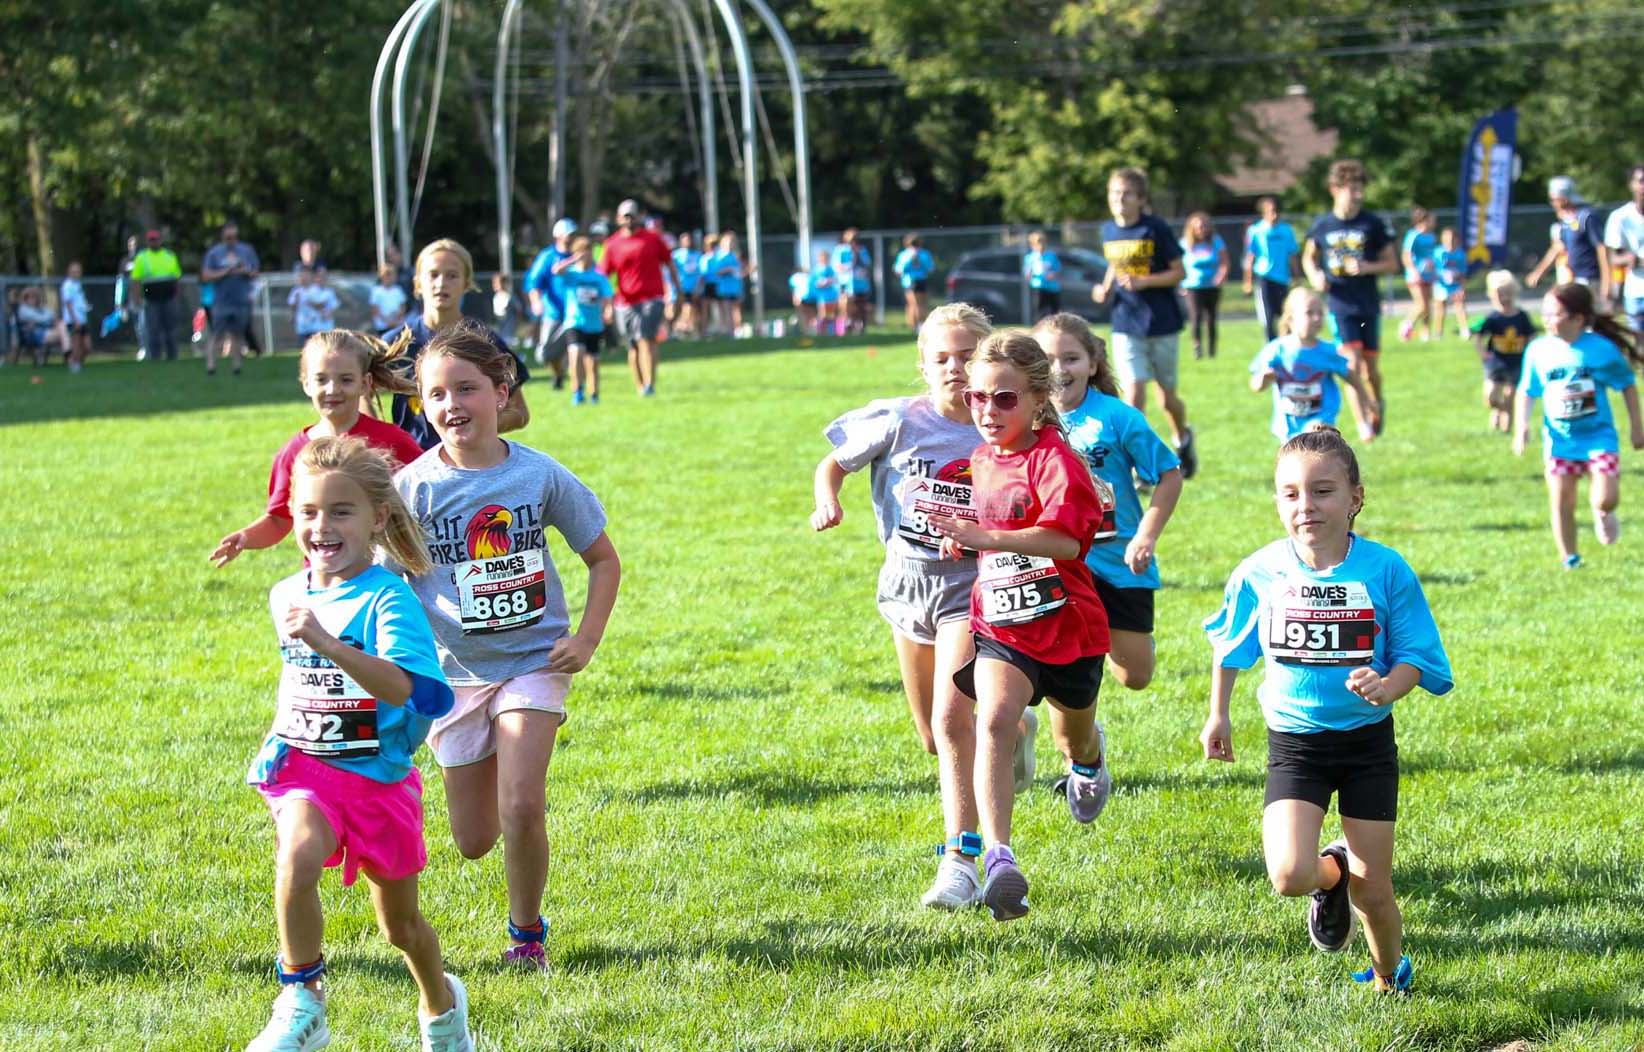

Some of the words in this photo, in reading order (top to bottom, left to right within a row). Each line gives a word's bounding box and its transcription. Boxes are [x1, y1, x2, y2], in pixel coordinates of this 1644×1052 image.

[932, 483, 972, 499] DAVE'S
[431, 515, 462, 540] LIT
[428, 541, 467, 565] FIRE
[485, 555, 525, 573] DAVE'S
[500, 574, 536, 590] COUNTRY
[993, 582, 1042, 613] 875
[1301, 585, 1347, 599] DAVE'S
[473, 590, 528, 620] 868
[1313, 610, 1360, 619] COUNTRY
[1286, 622, 1340, 650] 931
[301, 672, 344, 687] DAVE'S
